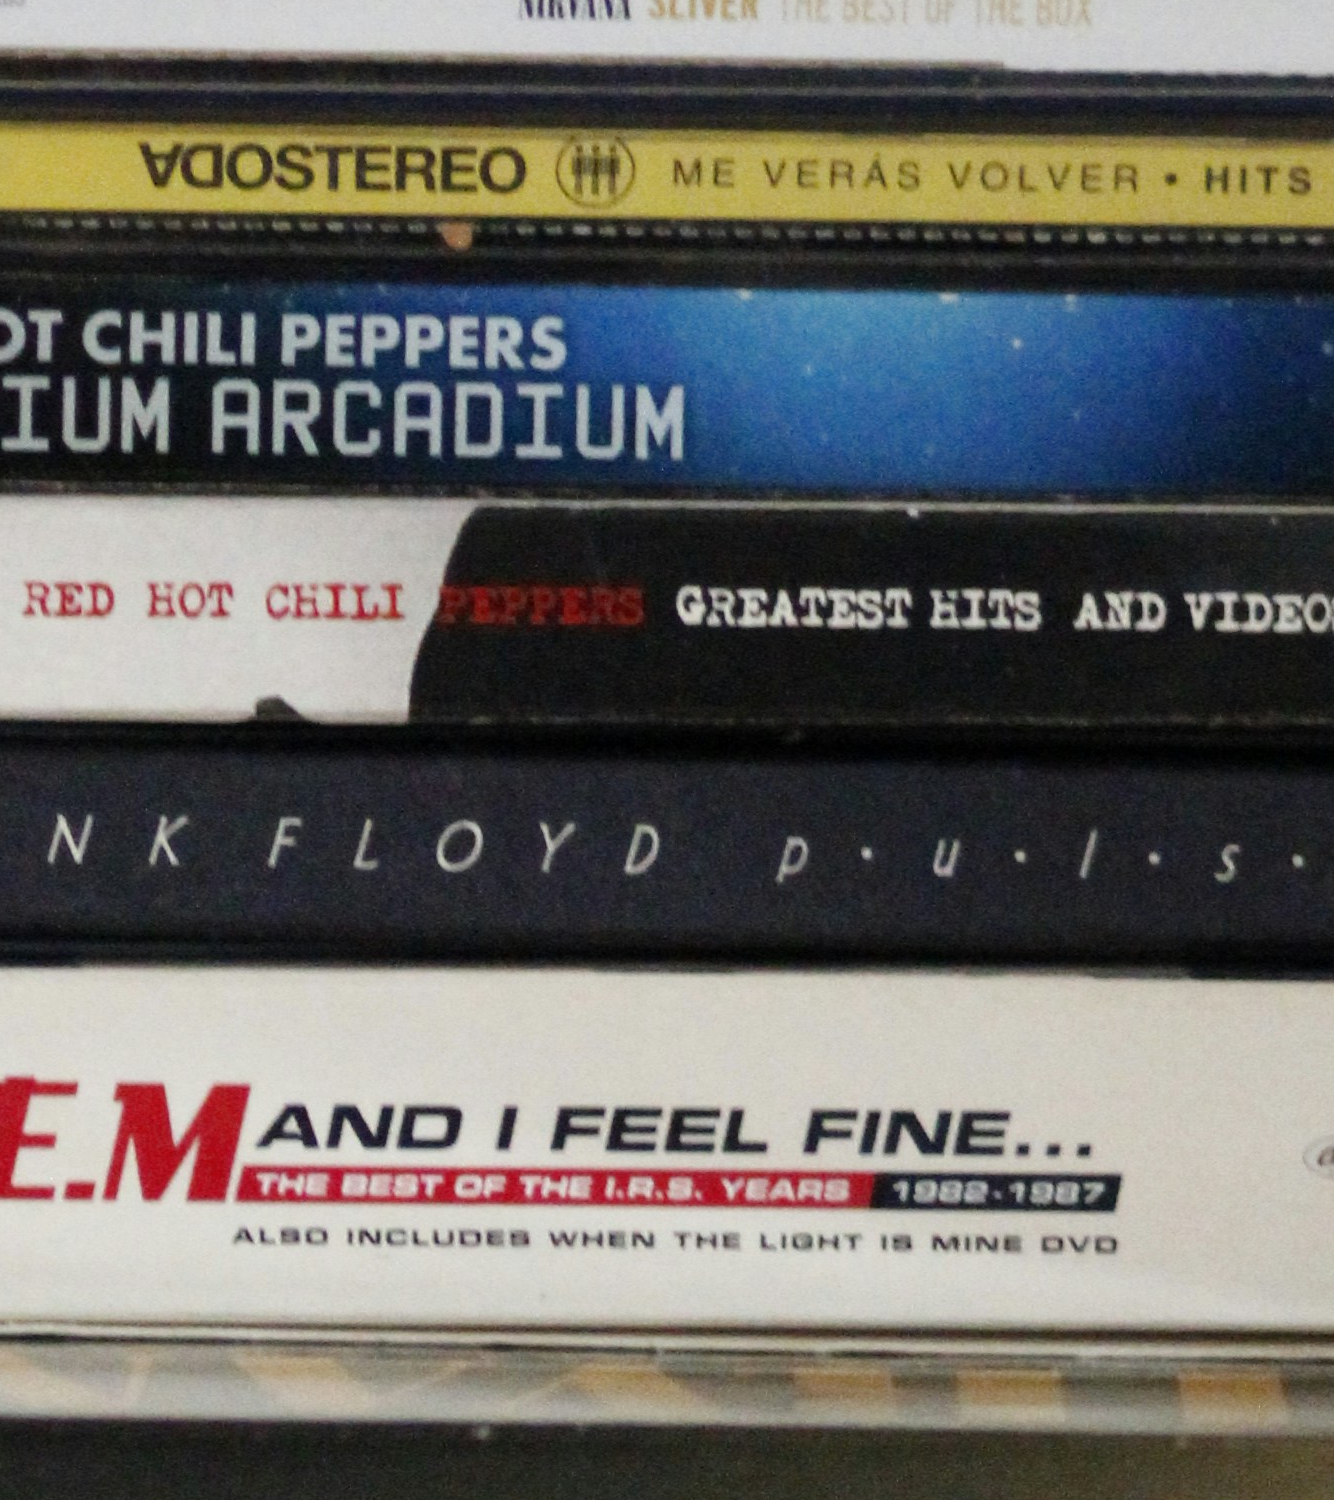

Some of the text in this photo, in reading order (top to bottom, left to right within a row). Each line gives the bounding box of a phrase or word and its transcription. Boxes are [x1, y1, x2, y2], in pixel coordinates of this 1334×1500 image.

[672, 160, 737, 188] ME
[764, 150, 922, 191] VERÁS
[948, 163, 1142, 192] VOLVER
[1203, 166, 1312, 198] HITS
[82, 312, 257, 367] CHILI
[281, 314, 567, 371] PEPPERS
[211, 379, 687, 464] ARCADIUM
[23, 582, 115, 620] RED
[147, 584, 235, 620] HOT
[265, 586, 405, 622] CHILI
[439, 588, 645, 626] PEPPERS
[675, 586, 911, 630] GREATEST
[930, 592, 1043, 632] HITS
[1074, 592, 1167, 633] AND
[268, 818, 661, 876] FLOYD
[257, 1106, 1095, 1157] AND I FEEL FINE...
[255, 1172, 325, 1197] THE
[340, 1173, 442, 1197] BEST
[454, 1174, 505, 1197] OF
[519, 1174, 591, 1199] THE
[603, 1175, 703, 1201] I.R.S.
[721, 1176, 851, 1203] YEARS
[233, 1227, 1118, 1254] ALSO INCLUDES WHEN THE LIGHT IS MINE DVD
